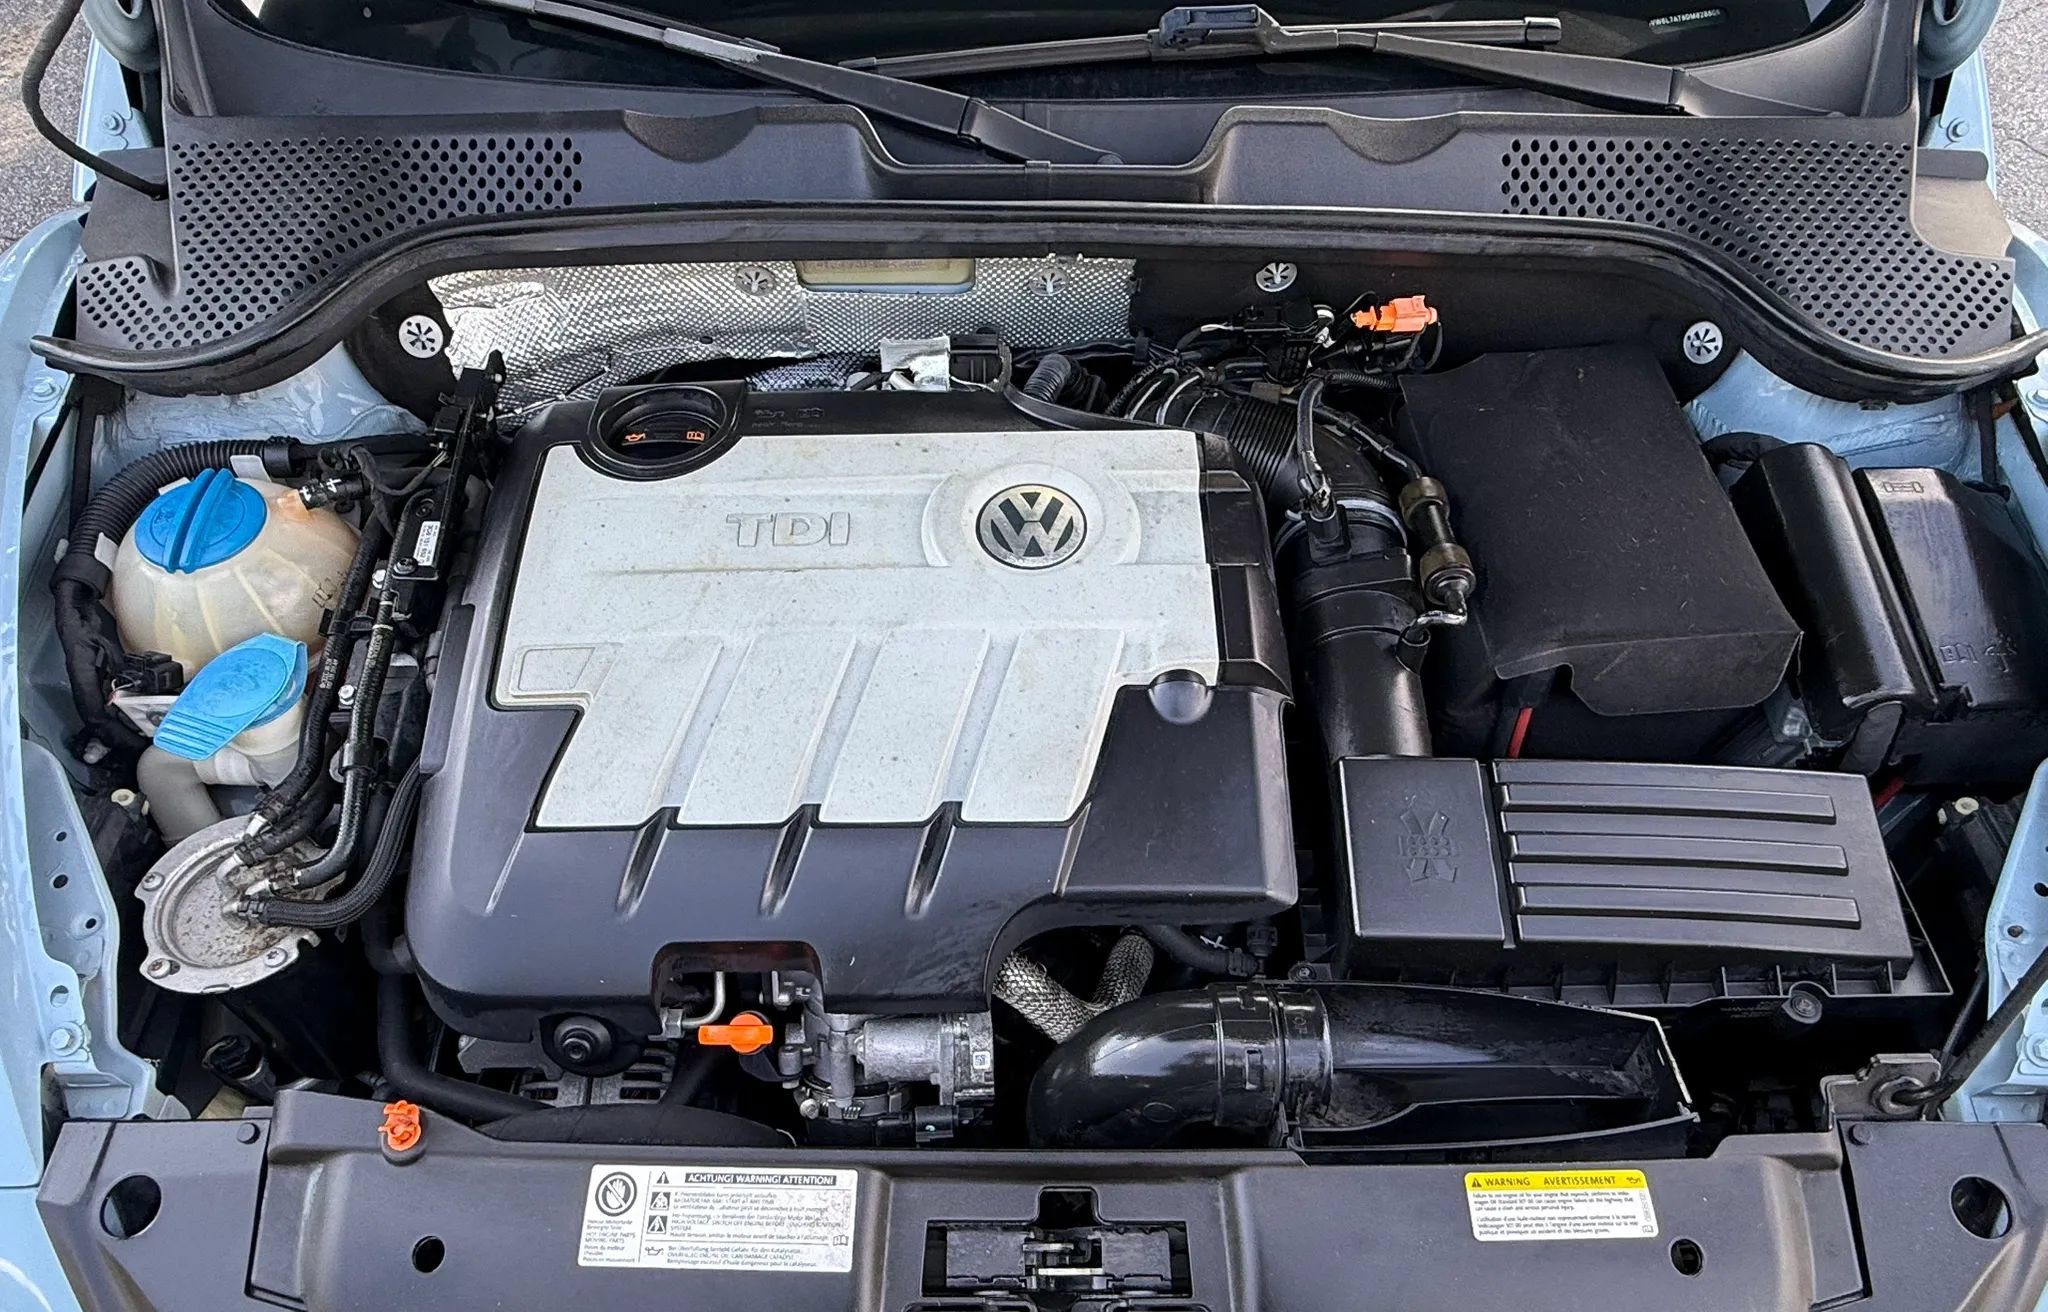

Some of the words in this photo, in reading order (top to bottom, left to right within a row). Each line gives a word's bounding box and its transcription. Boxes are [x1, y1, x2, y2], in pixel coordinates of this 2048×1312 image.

[726, 511, 850, 547] TDI
[980, 486, 1084, 567] VW
[688, 1173, 734, 1183] ACHTUNG!
[735, 1174, 781, 1184] WARNING!
[782, 1175, 834, 1185] ATTENTION!
[1484, 1177, 1531, 1186] WARNING
[1543, 1176, 1616, 1186] AVERTISSEMENT
